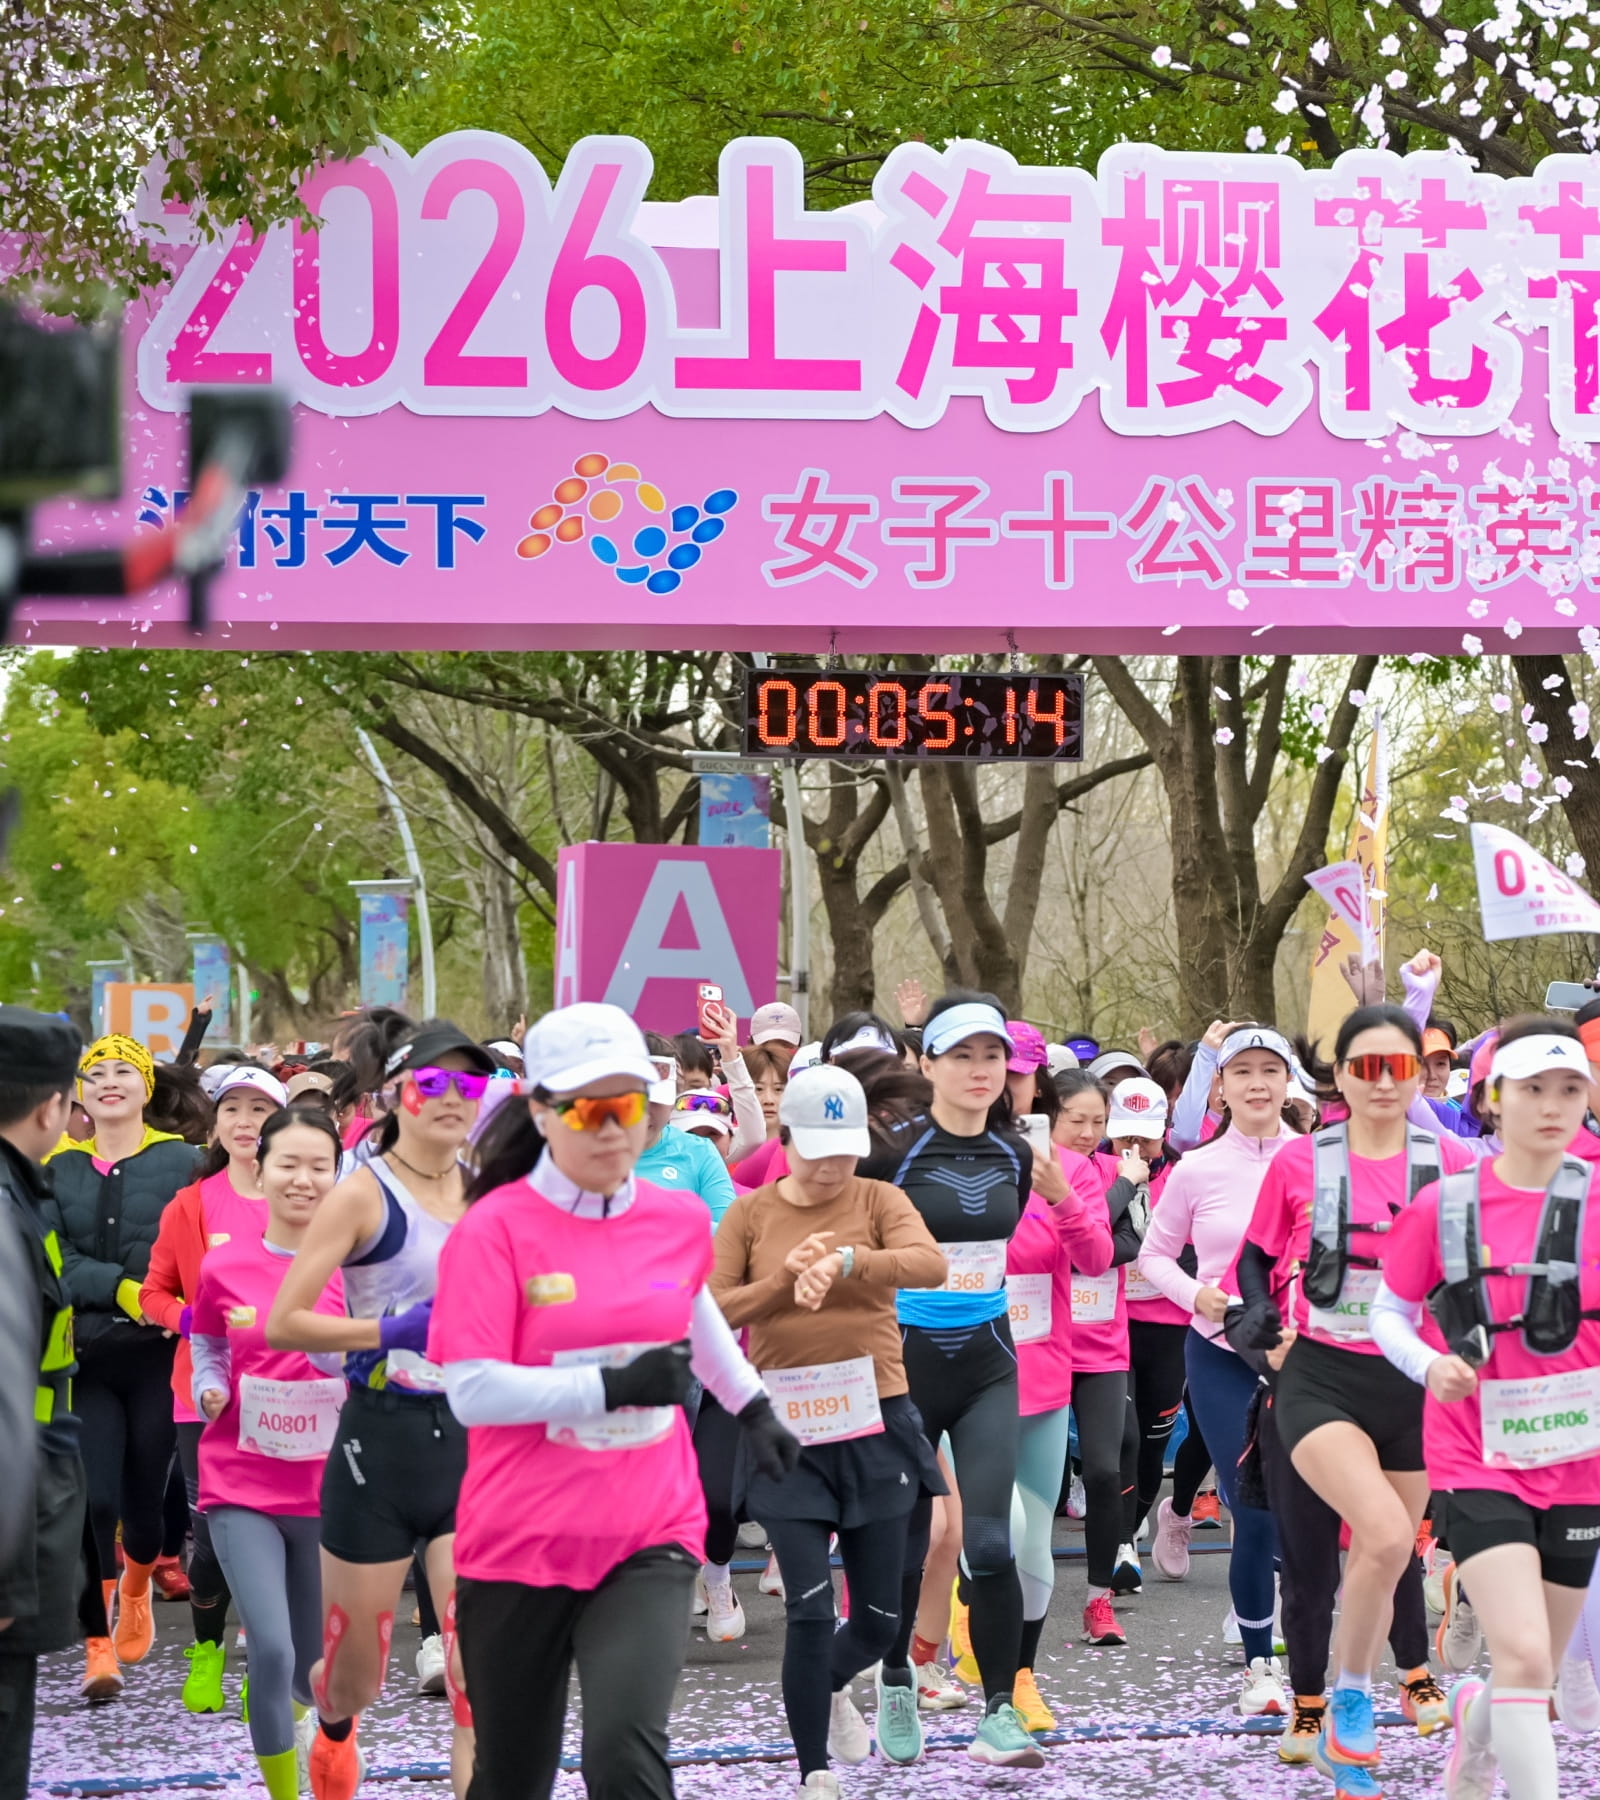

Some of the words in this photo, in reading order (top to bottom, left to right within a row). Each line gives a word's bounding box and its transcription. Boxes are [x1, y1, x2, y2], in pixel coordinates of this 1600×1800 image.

[757, 680, 1065, 749] 00:05:14
[603, 859, 756, 1019] A
[131, 989, 188, 1062] B
[1072, 1288, 1100, 1306] 361
[786, 1394, 851, 1420] B1891
[258, 1411, 318, 1434] A0801
[1502, 1408, 1589, 1435] PACER06
